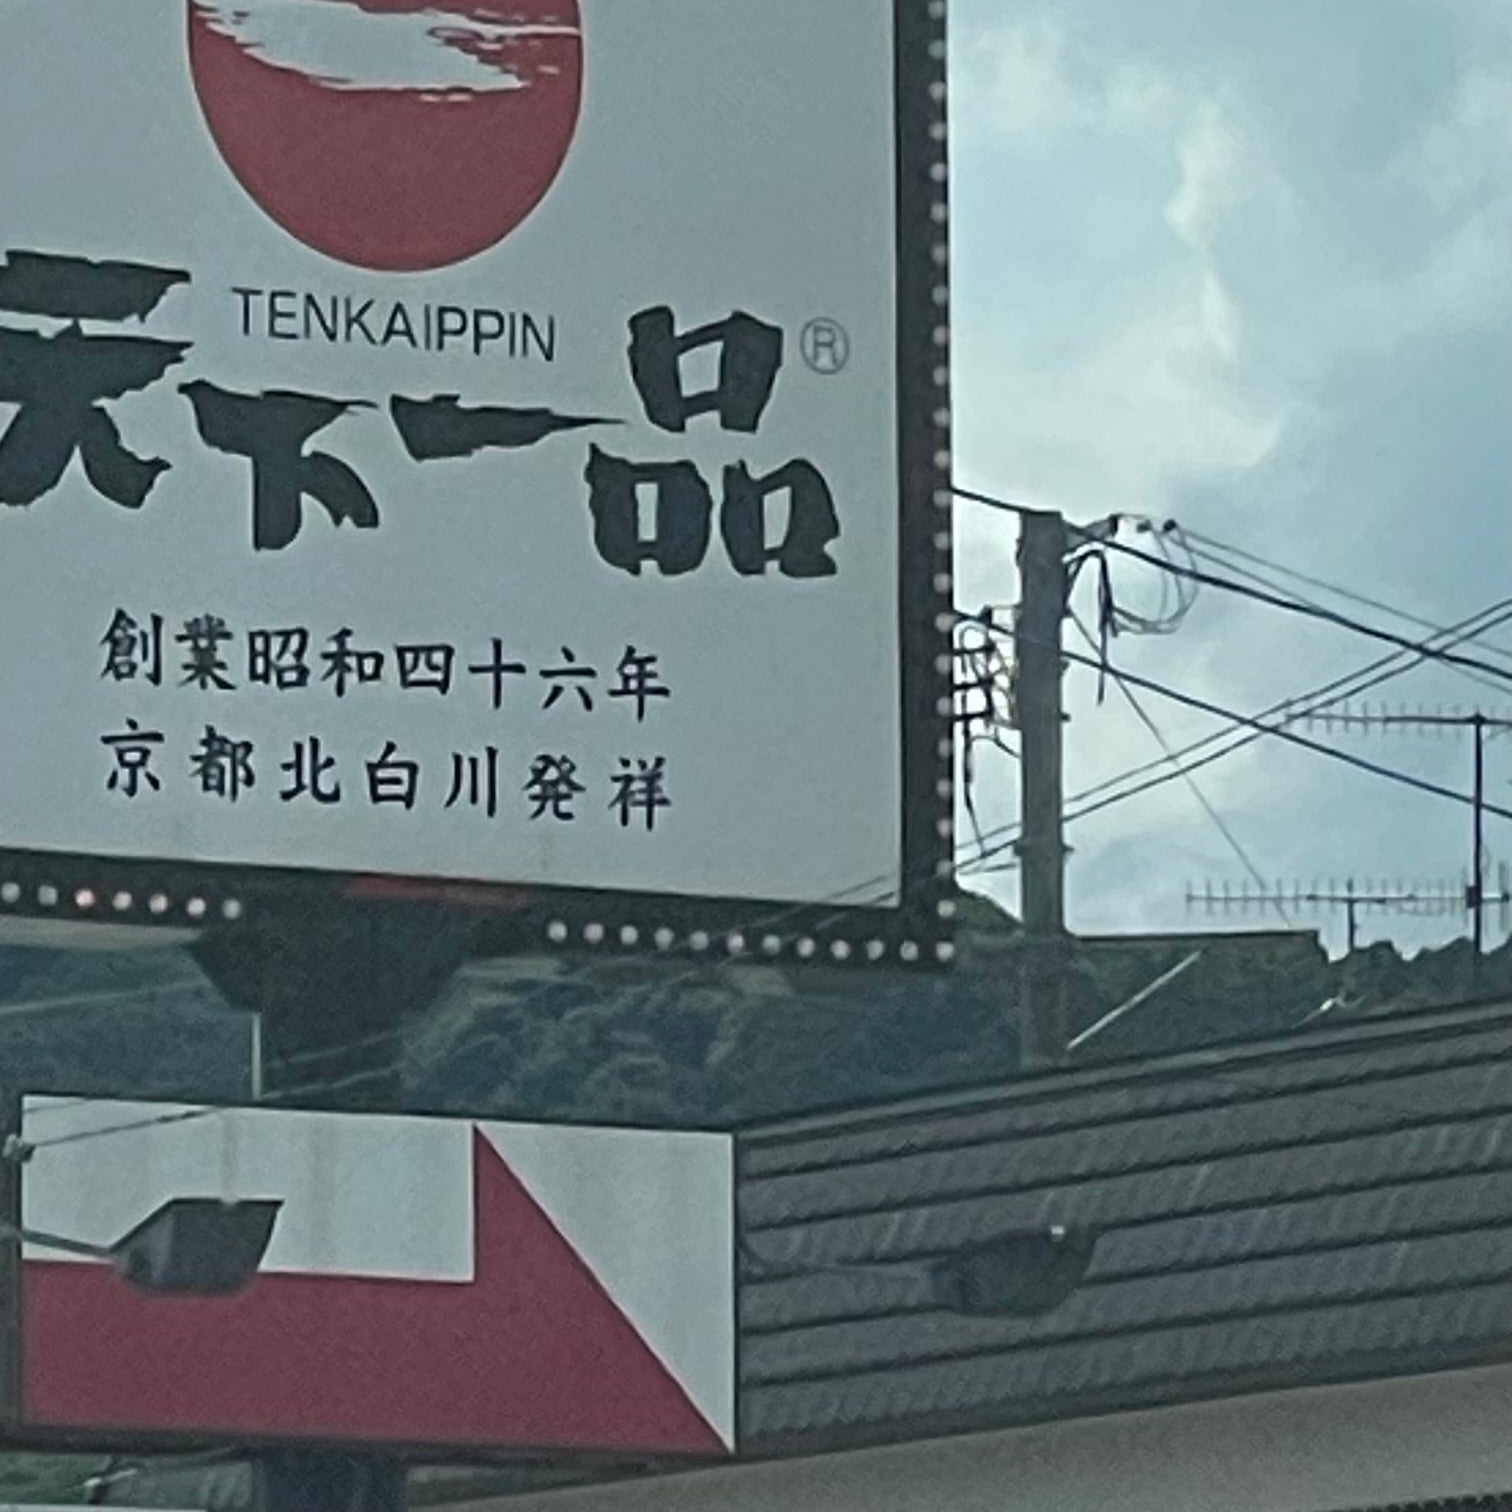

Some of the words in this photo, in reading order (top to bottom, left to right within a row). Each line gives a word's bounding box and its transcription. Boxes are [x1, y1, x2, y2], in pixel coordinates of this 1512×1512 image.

[231, 287, 558, 363] TENKAIPPIN
[99, 607, 672, 724] 創業昭和四十六年
[99, 718, 674, 832] 京都北白川発祥
